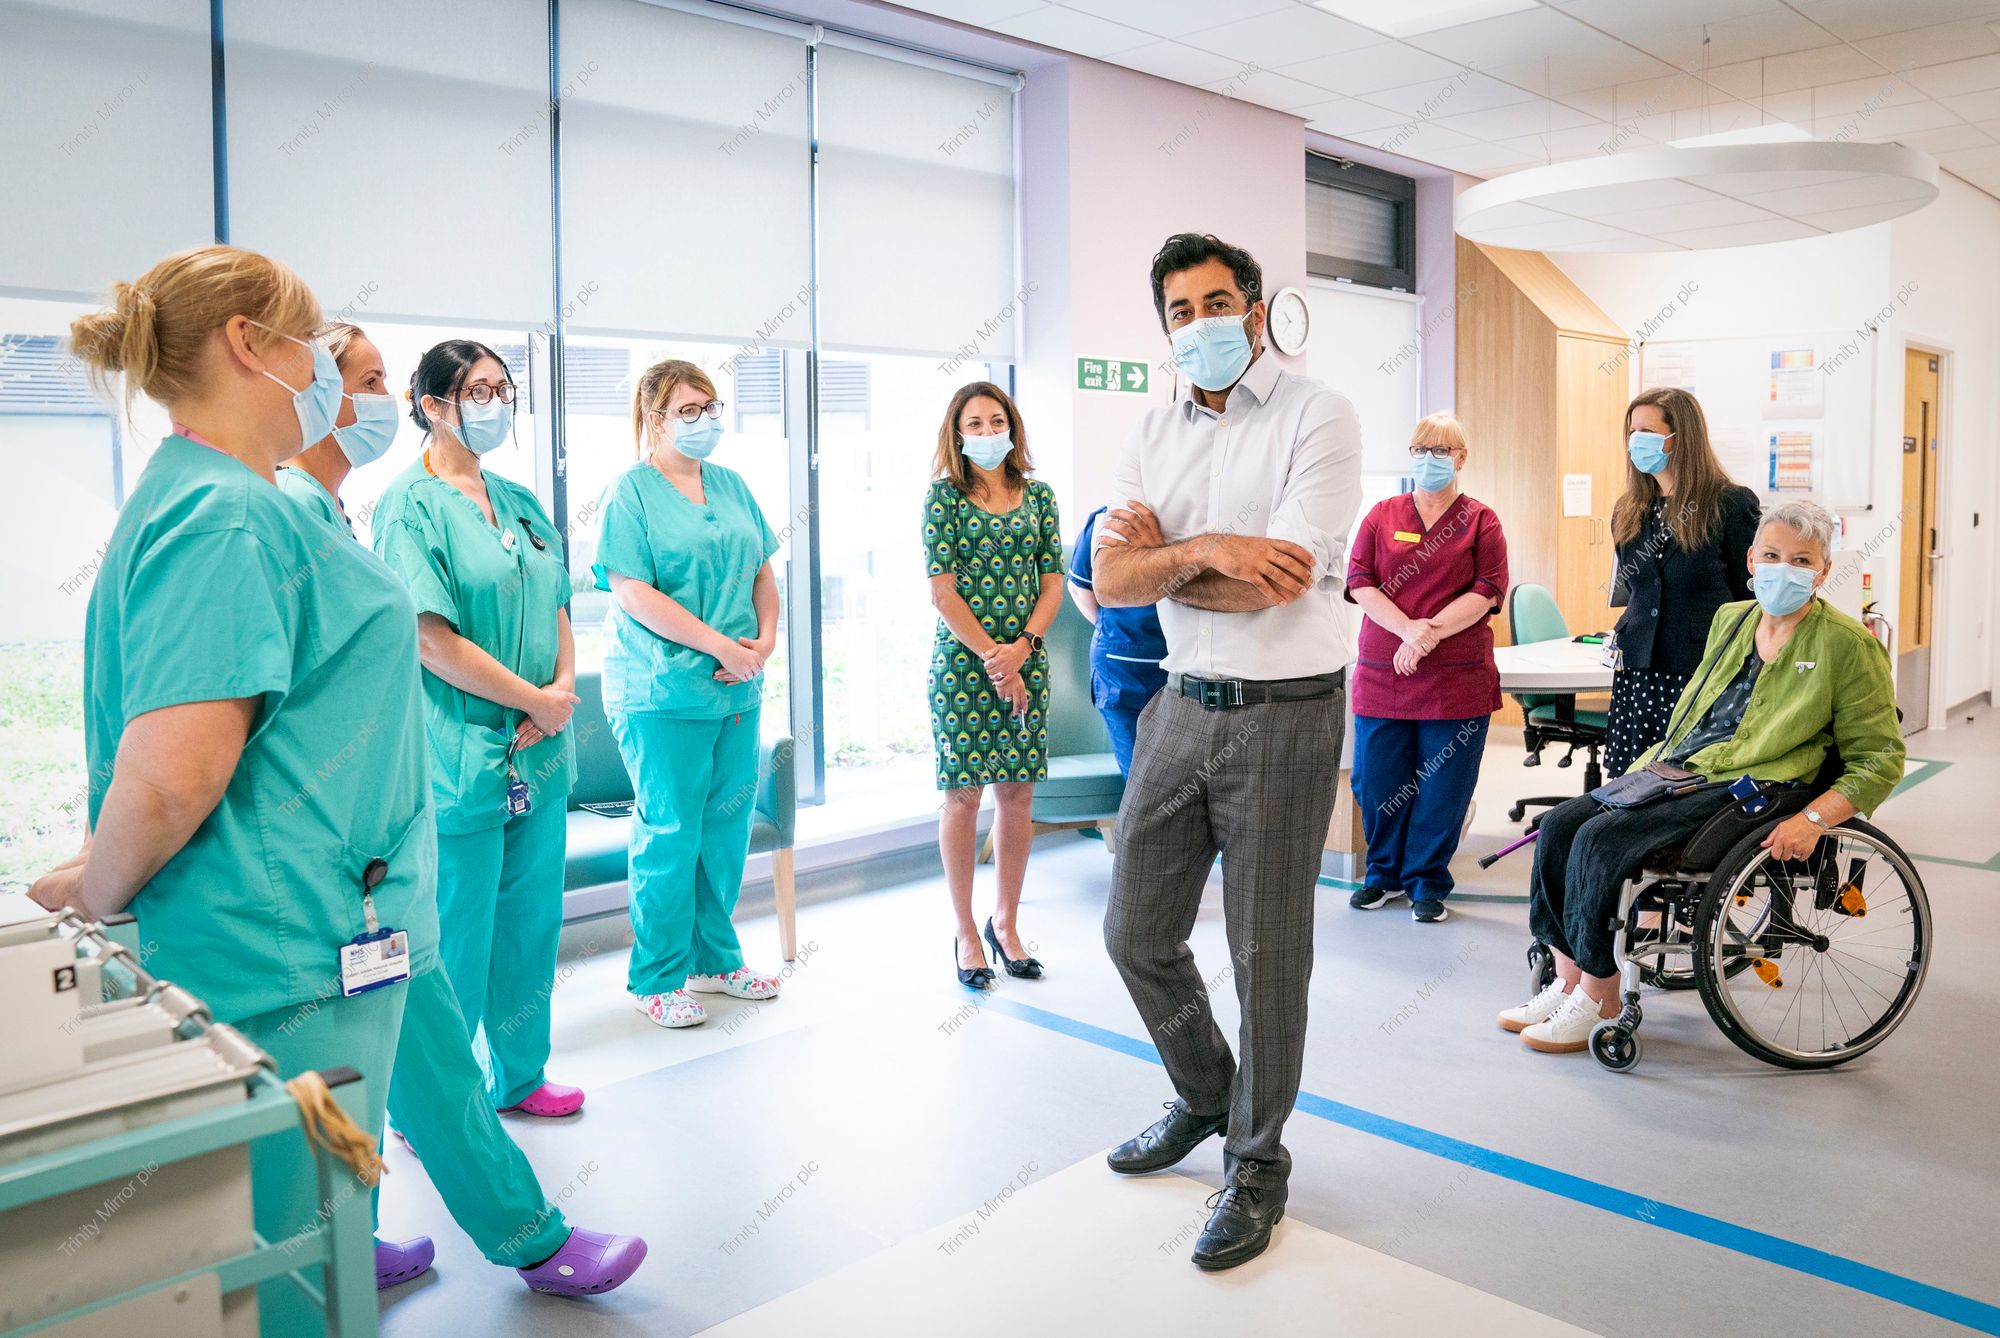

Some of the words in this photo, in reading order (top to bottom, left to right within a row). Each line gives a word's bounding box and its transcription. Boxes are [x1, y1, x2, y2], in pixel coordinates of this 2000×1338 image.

[1084, 361, 1102, 374] Fire
[1084, 375, 1102, 387] exit
[57, 968, 74, 990] 2
